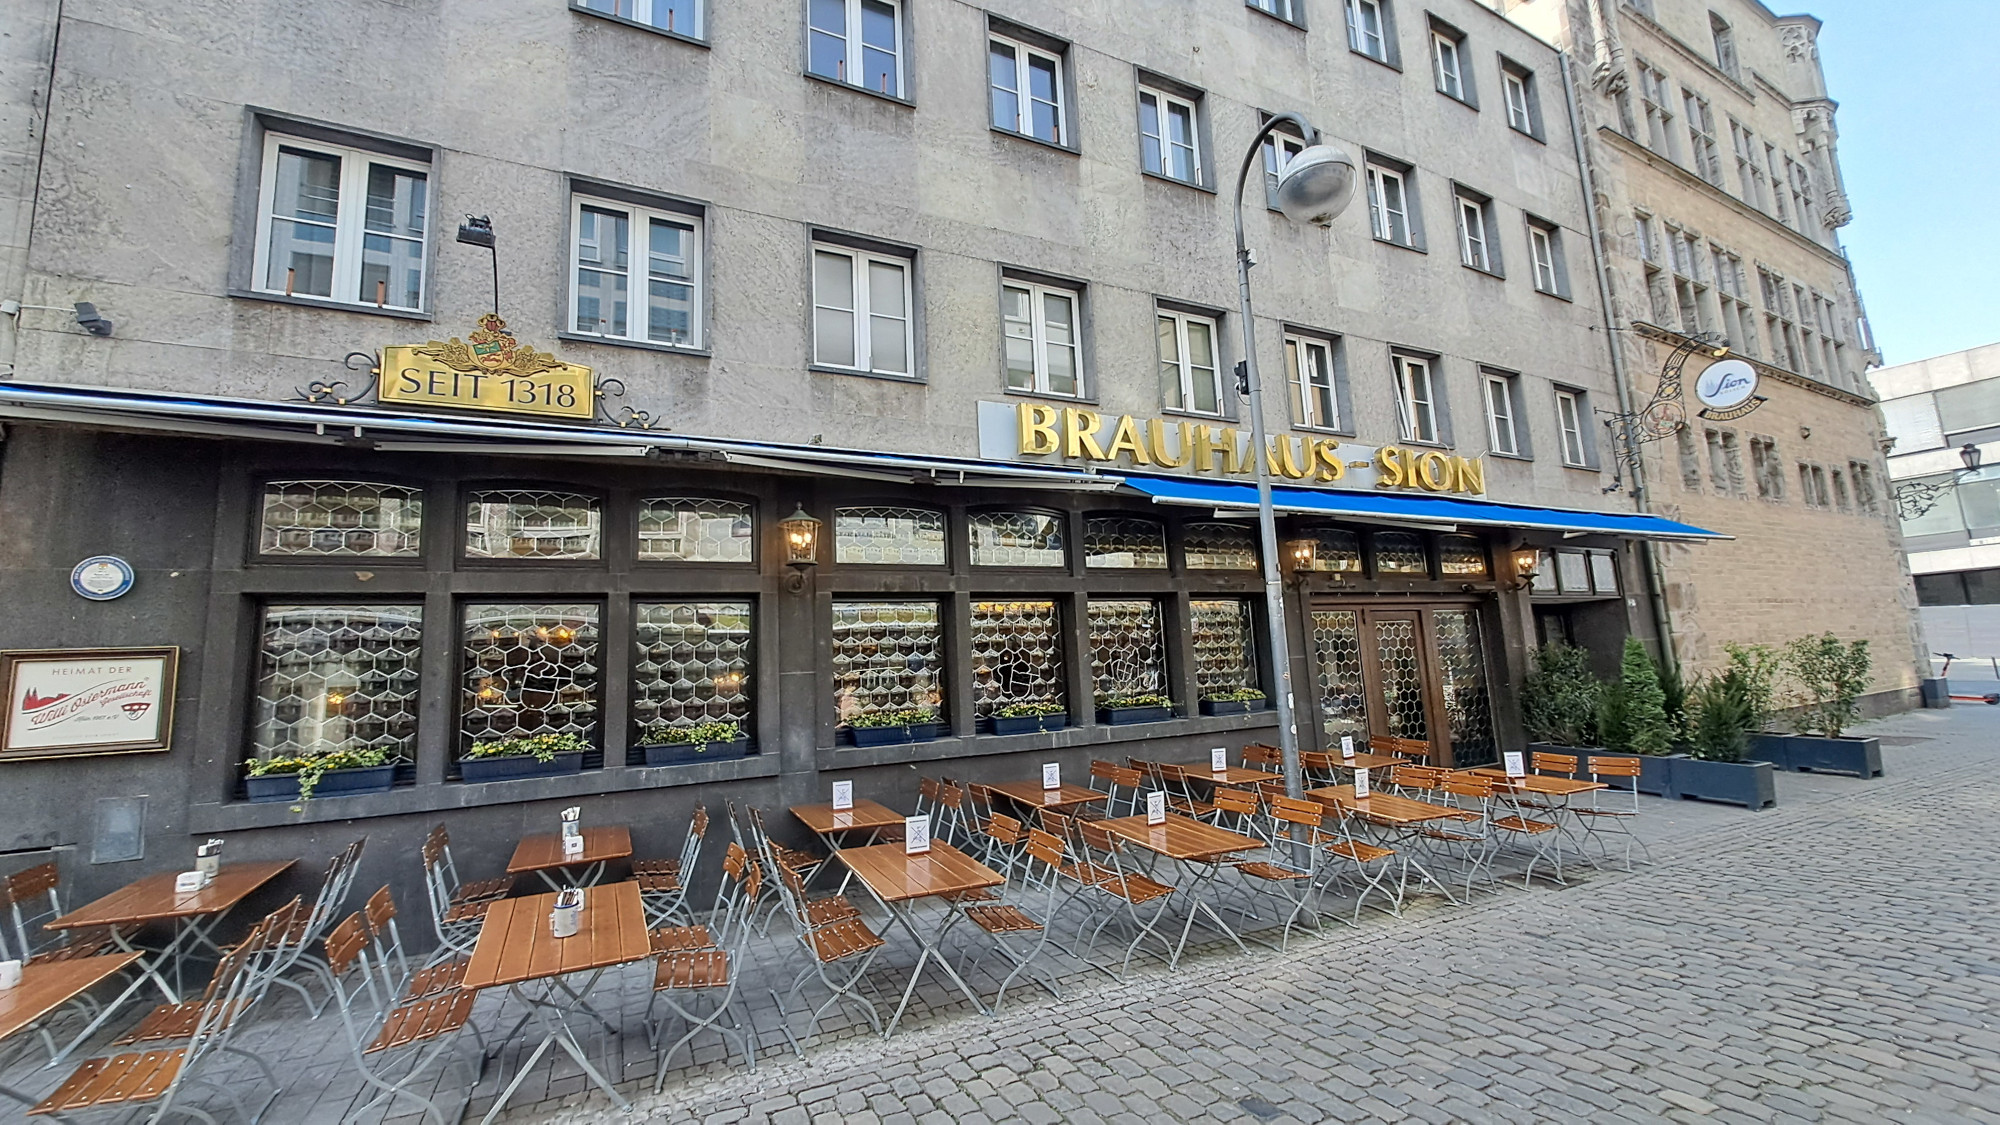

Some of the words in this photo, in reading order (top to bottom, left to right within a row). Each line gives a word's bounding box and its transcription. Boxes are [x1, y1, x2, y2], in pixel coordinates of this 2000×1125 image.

[399, 367, 489, 399] SEIT
[500, 378, 576, 408] 1318
[1703, 398, 1761, 420] BRAUHAUS
[1374, 445, 1485, 495] SION
[51, 667, 103, 676] HEIMAT
[108, 666, 133, 674] DER
[31, 704, 69, 725] Willi
[70, 680, 146, 713] Ostermann
[99, 690, 153, 708] Gesellschaft
